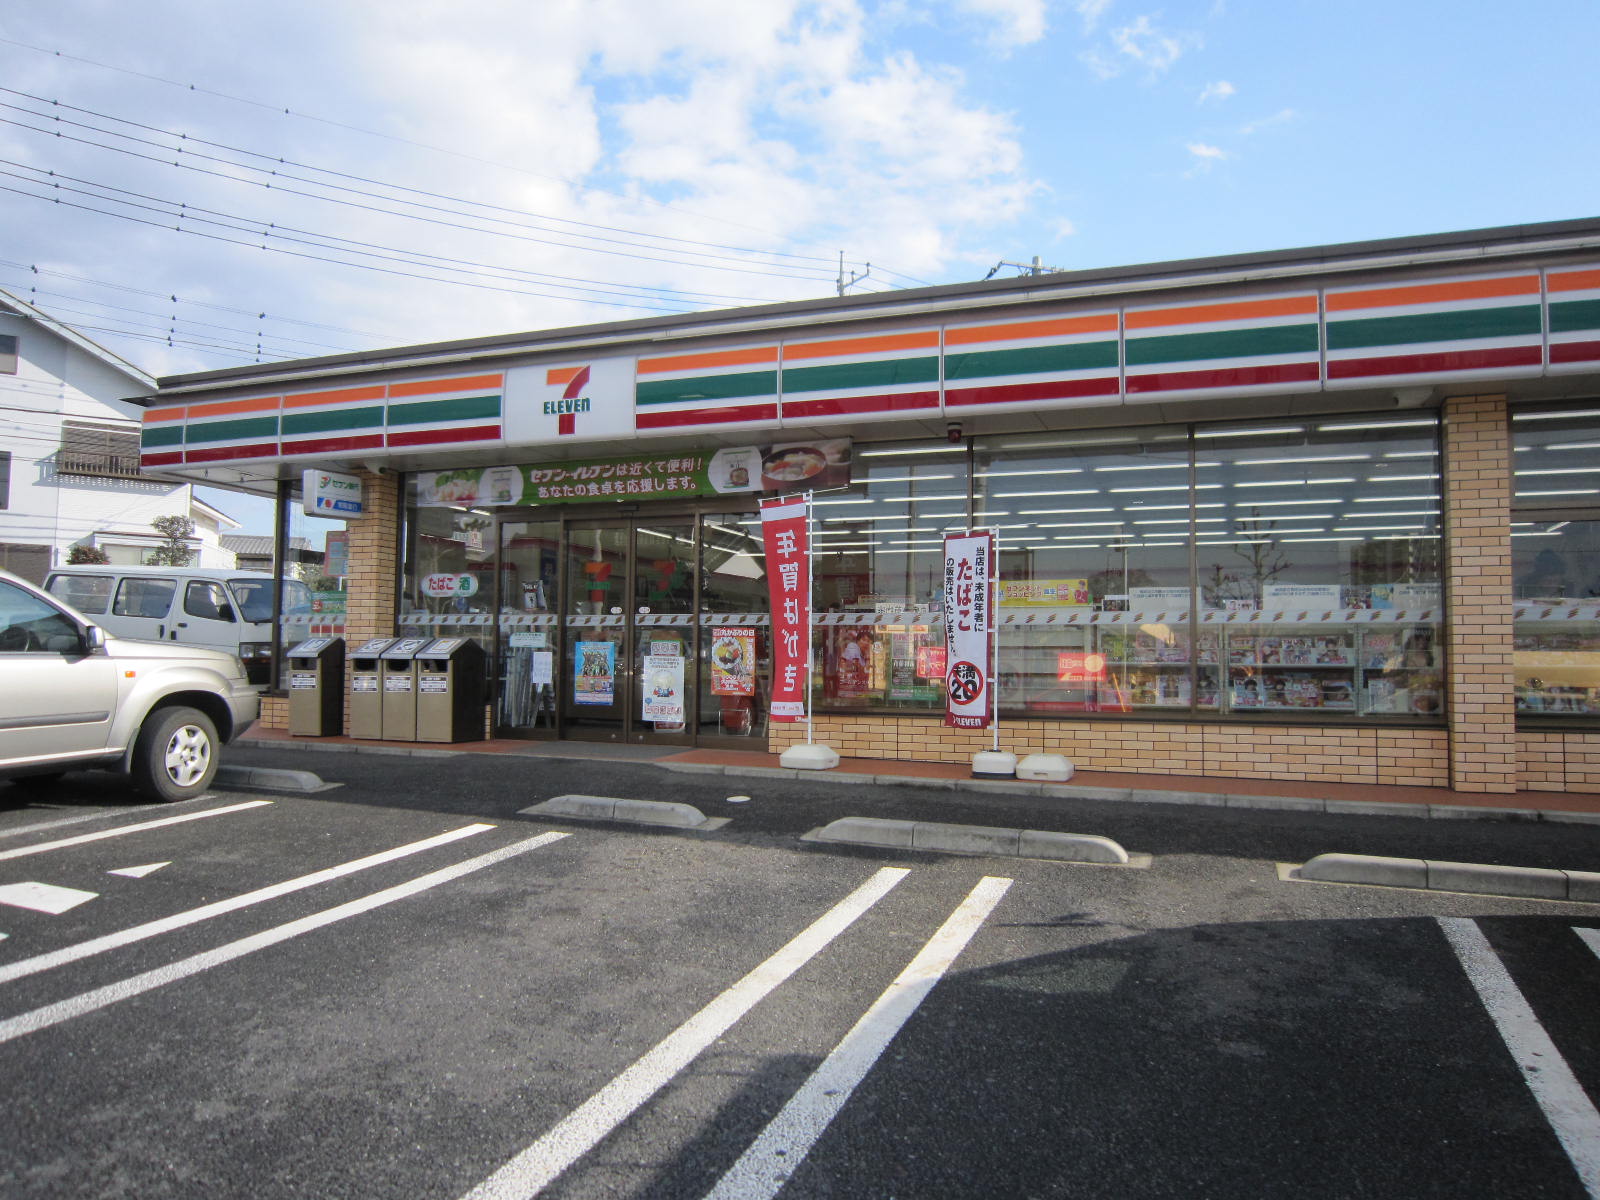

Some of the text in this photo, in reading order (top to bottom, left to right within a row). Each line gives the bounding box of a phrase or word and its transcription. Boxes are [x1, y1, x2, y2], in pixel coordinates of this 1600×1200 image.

[546, 365, 591, 435] 7
[537, 475, 696, 498] あなたの食卓を応援します。
[429, 576, 471, 590] たばこ 酒
[957, 557, 973, 632] たばこ
[974, 546, 985, 632] 当店は、未成年者に
[952, 680, 978, 700] 20
